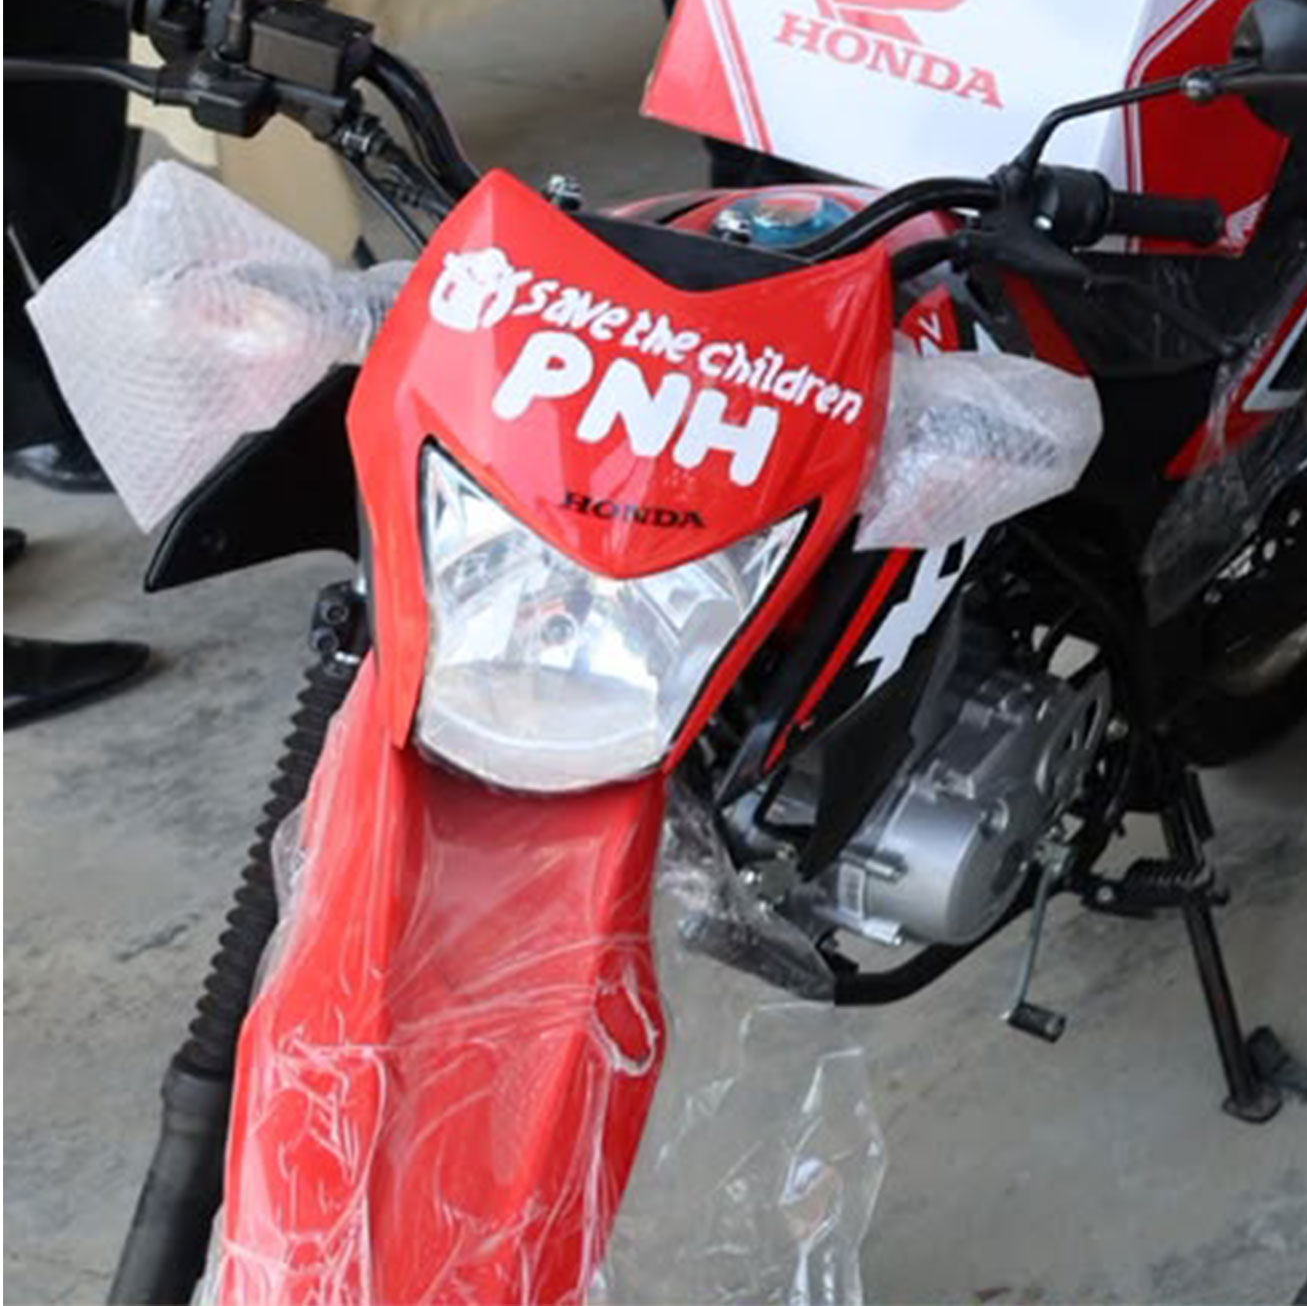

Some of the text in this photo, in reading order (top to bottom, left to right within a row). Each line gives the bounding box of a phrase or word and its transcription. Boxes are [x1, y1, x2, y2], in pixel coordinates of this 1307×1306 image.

[773, 10, 1004, 109] HONDA
[621, 310, 701, 363] the
[492, 329, 780, 486] PNH
[558, 490, 706, 529] HONDA
